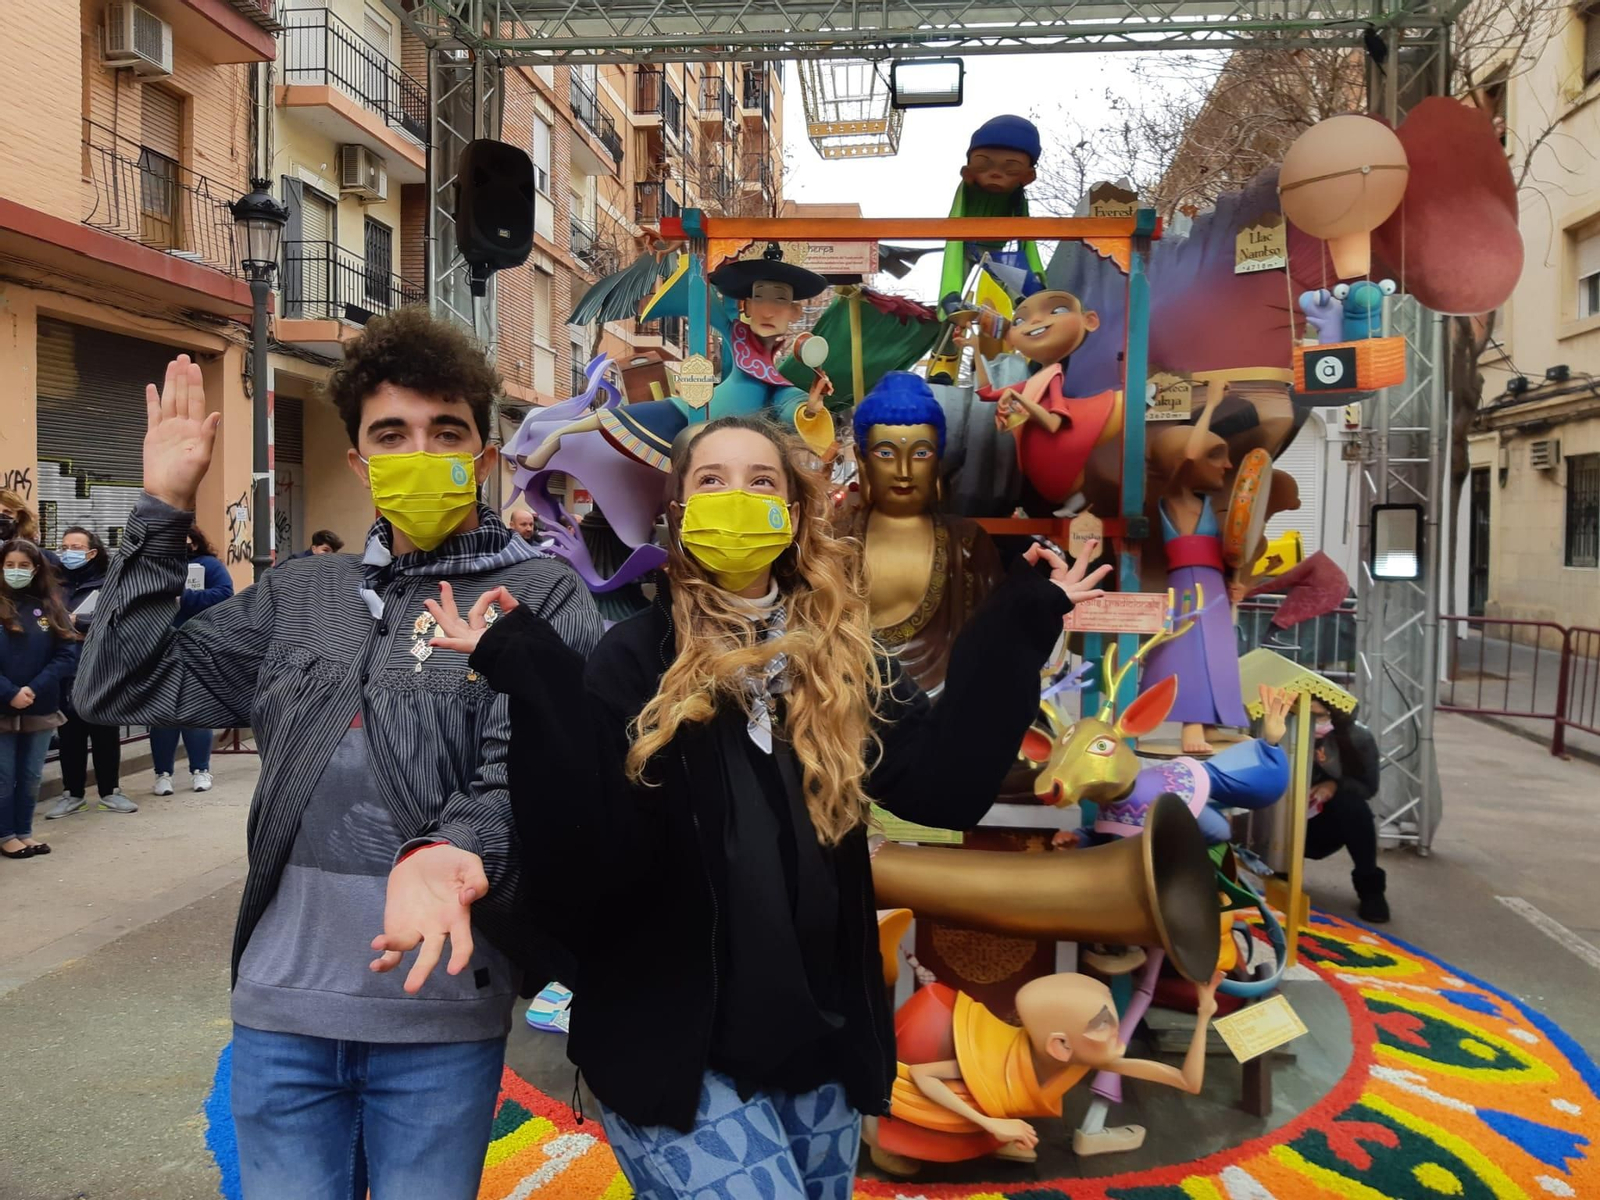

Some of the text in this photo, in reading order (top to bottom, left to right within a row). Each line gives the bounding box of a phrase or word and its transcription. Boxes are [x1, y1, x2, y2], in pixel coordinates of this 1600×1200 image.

[1250, 231, 1272, 244] Llac
[1240, 245, 1281, 260] Namtso
[1155, 395, 1182, 410] akya
